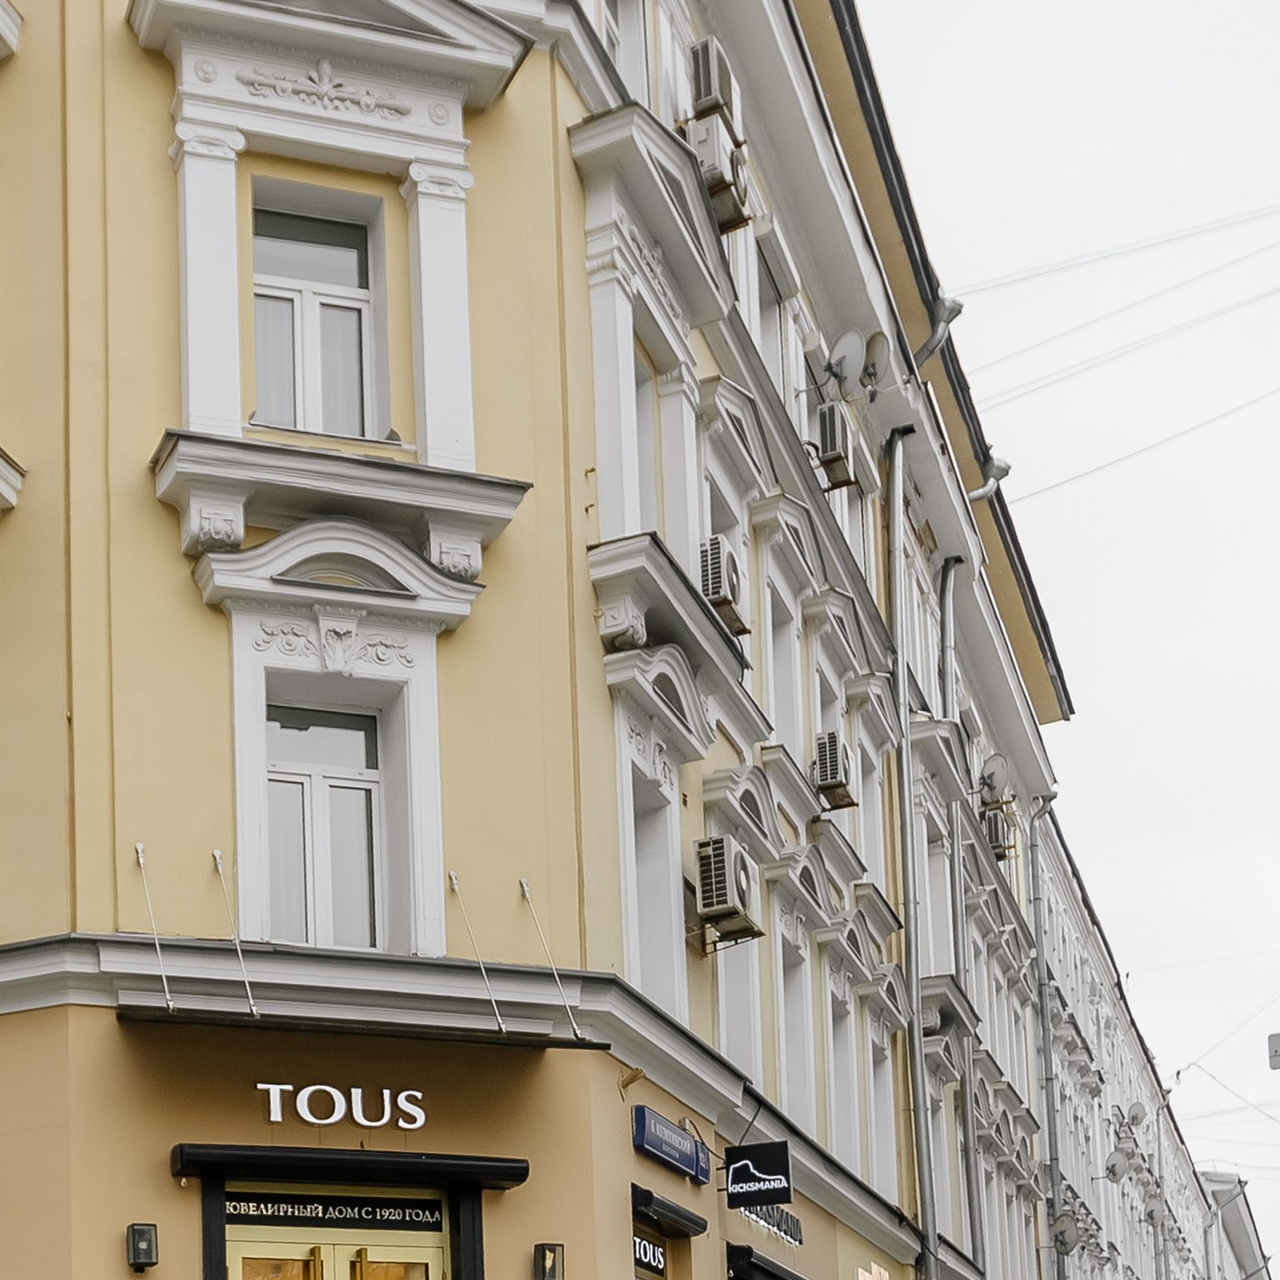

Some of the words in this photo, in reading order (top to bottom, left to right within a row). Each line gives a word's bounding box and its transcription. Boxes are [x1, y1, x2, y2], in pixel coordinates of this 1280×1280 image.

[256, 1082, 427, 1130] TOUS
[728, 1179, 788, 1193] KICKSMANIA
[225, 1201, 323, 1217] ЮВЕЛИРНЫЙ
[325, 1205, 360, 1219] ДОМ
[375, 1208, 403, 1220] 1920
[405, 1208, 442, 1222] ГОДА
[633, 1236, 665, 1269] TOUS
